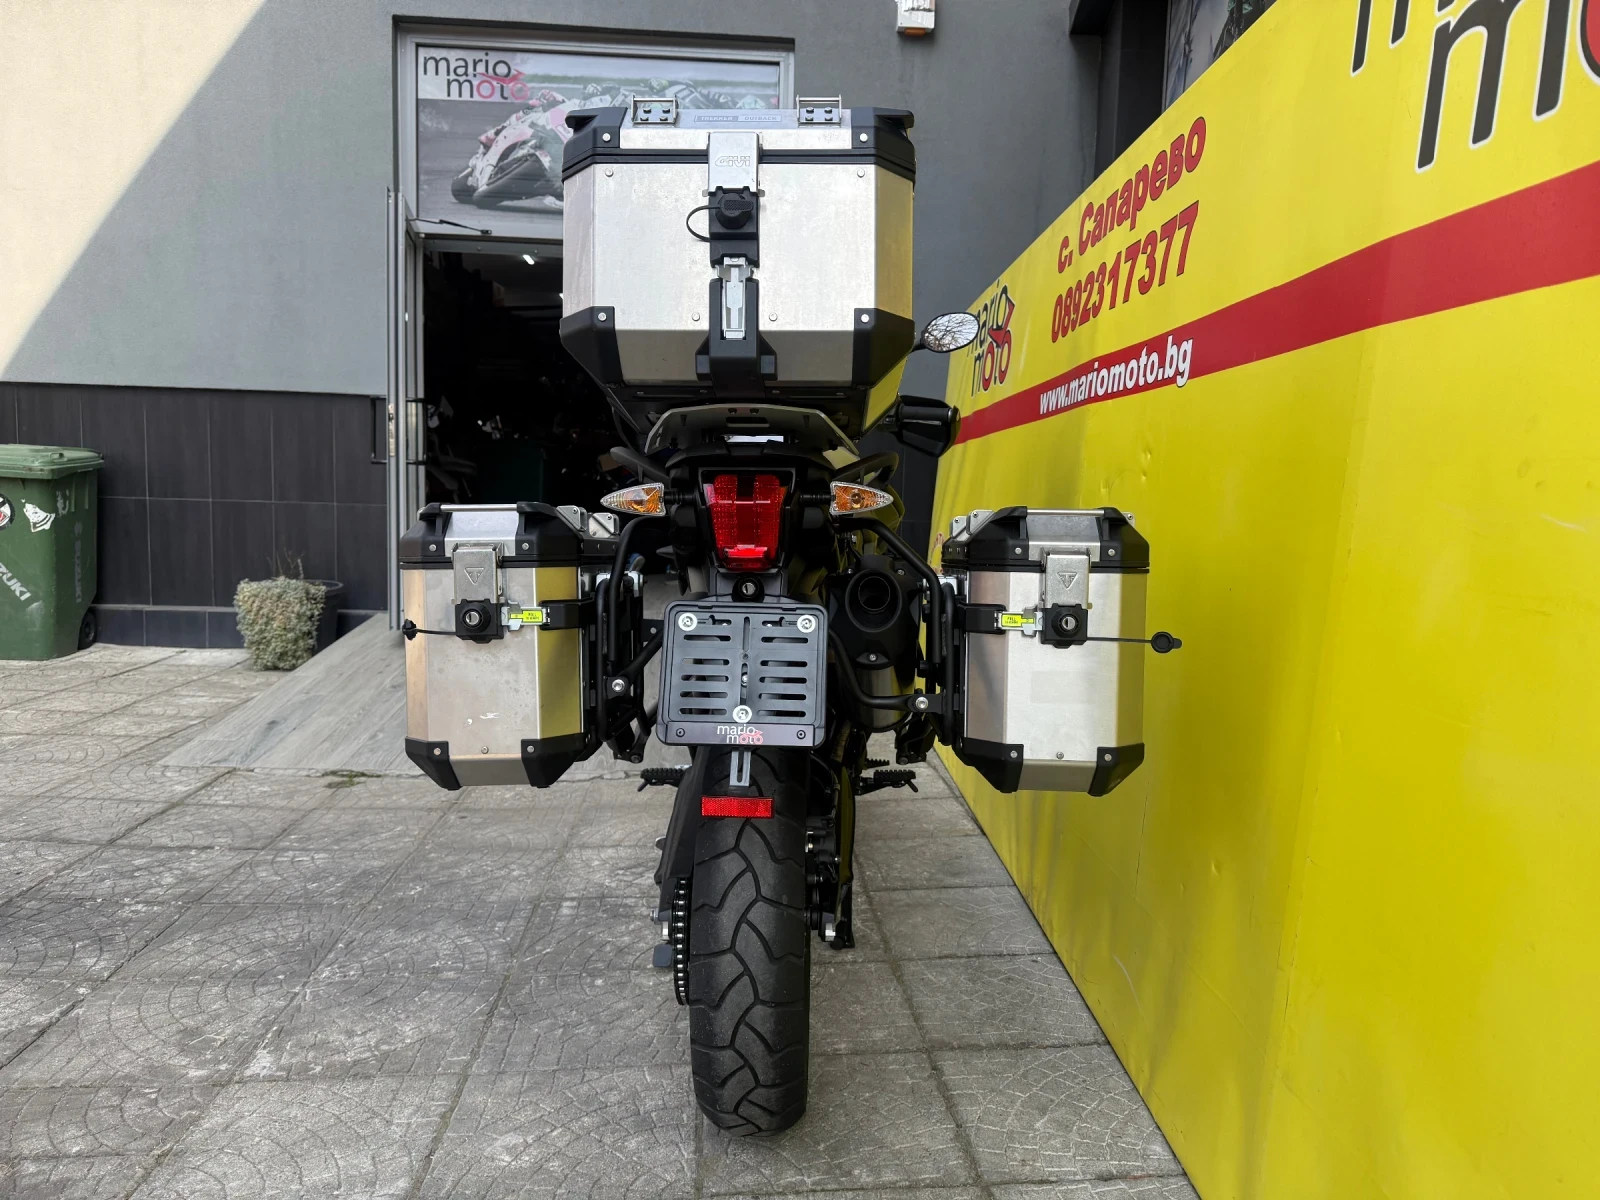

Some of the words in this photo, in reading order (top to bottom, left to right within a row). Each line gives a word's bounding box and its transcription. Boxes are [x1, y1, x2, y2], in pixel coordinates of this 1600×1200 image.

[423, 51, 512, 79] mario
[446, 78, 529, 101] moto
[1078, 116, 1207, 256] Сапарево
[1051, 200, 1199, 344] 0892317377
[1039, 335, 1193, 415] www.mariomoto.bg
[716, 724, 756, 735] mario
[726, 734, 763, 744] moto
